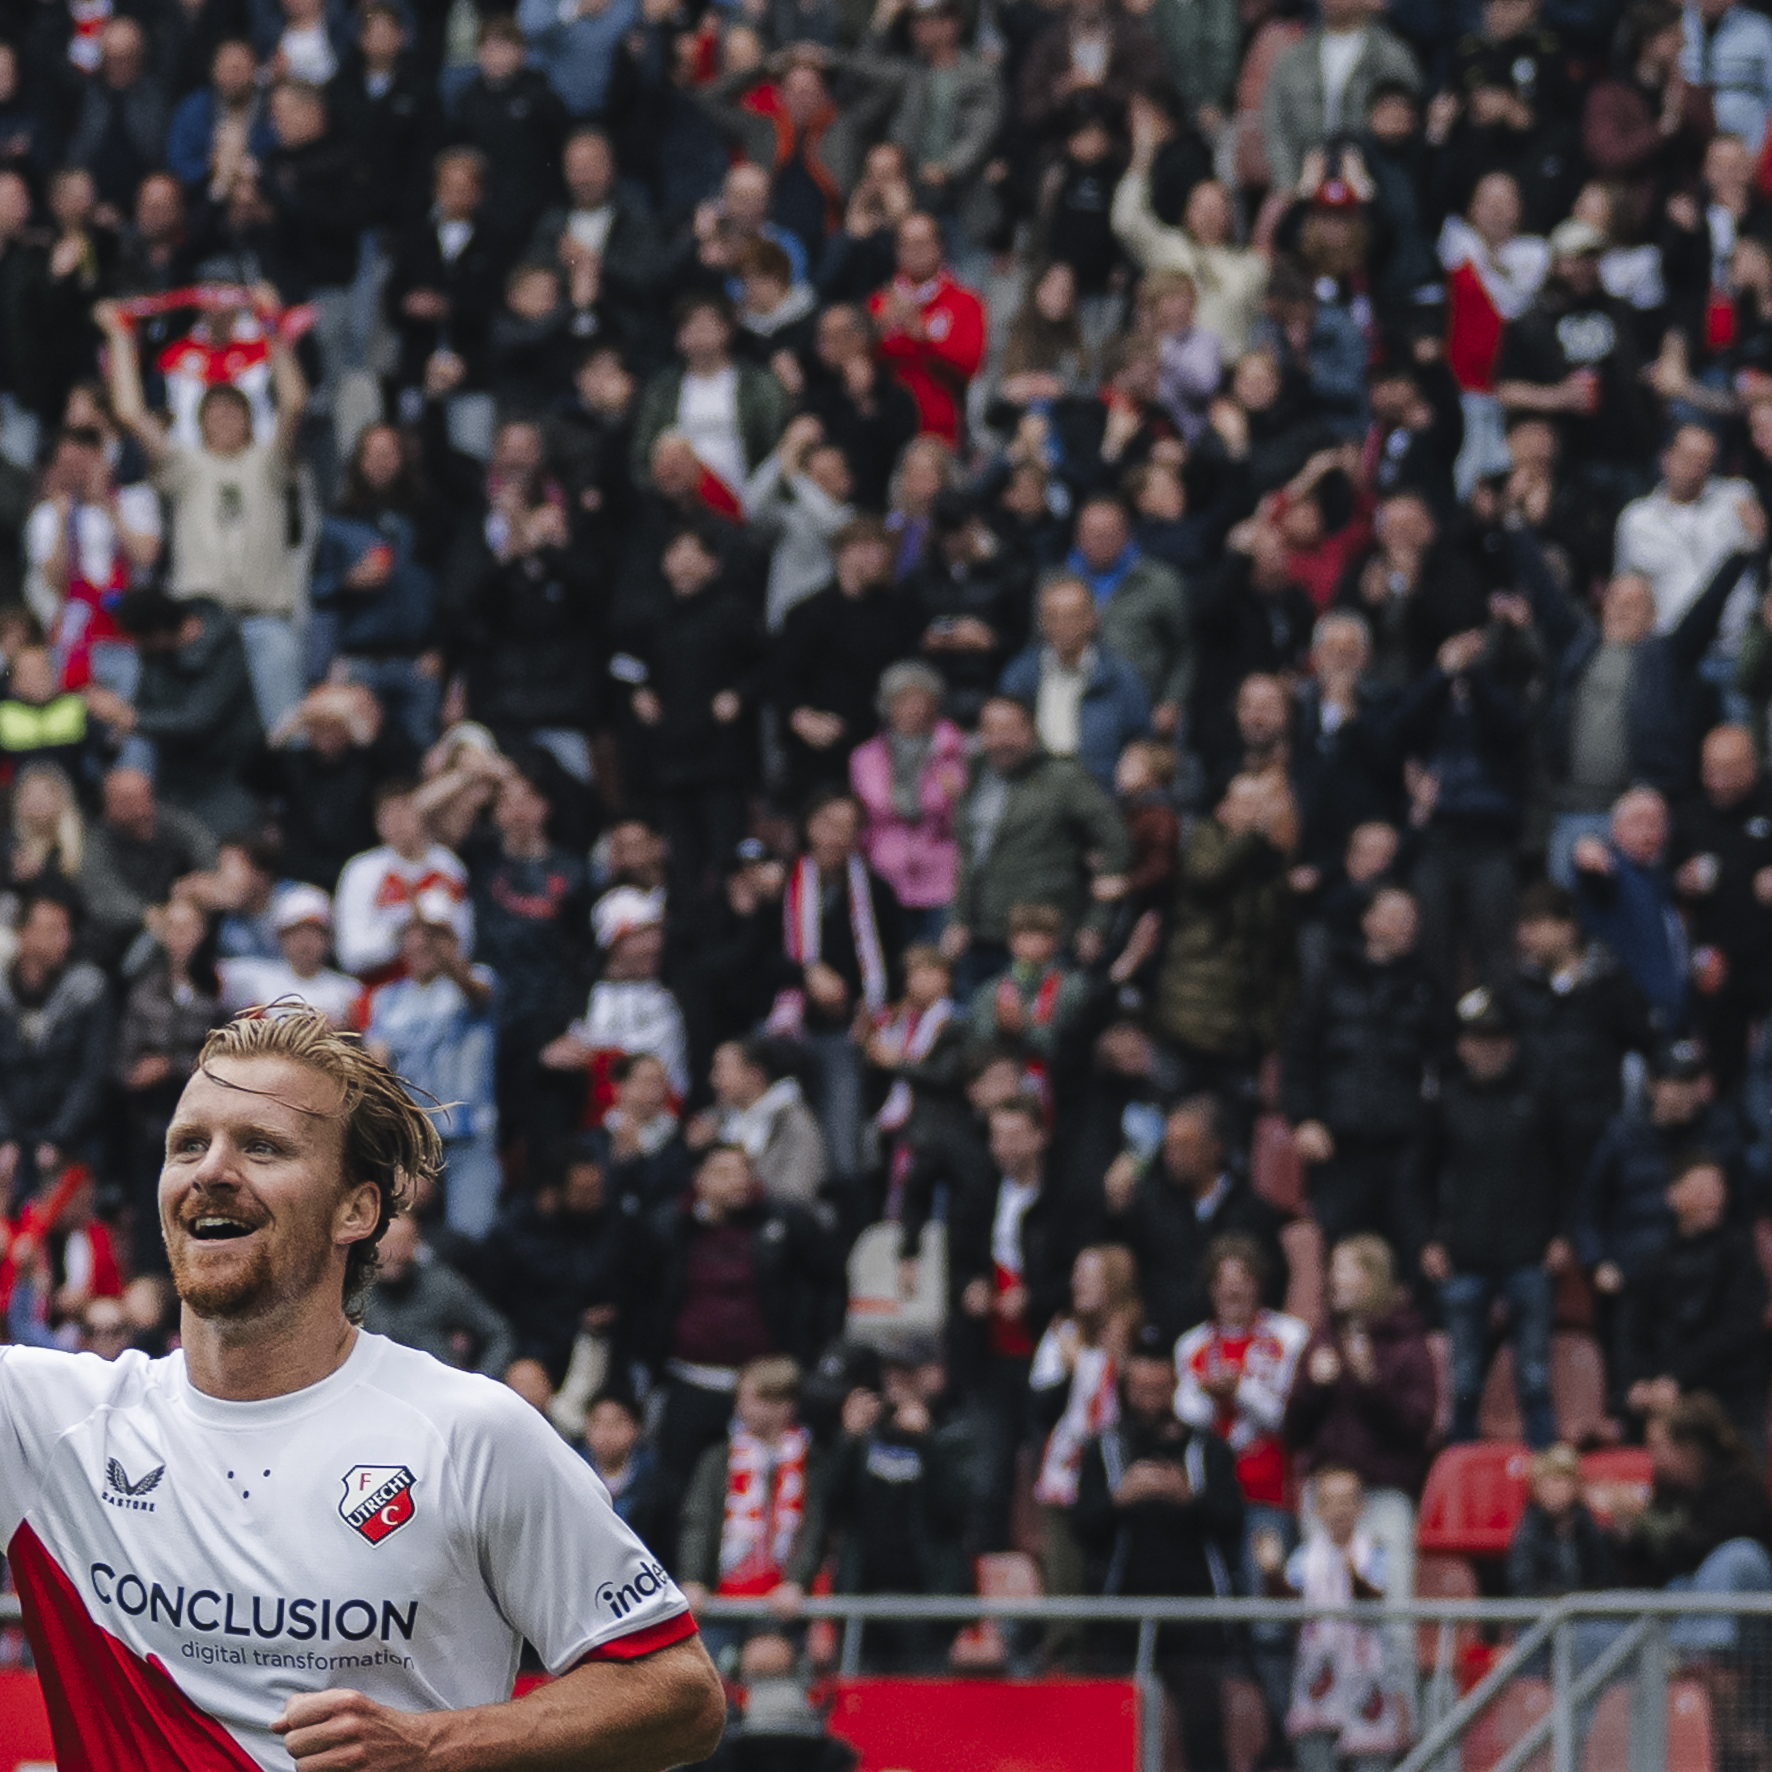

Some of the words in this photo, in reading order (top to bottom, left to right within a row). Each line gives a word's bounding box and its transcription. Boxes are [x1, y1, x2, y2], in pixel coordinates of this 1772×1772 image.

[347, 1470, 412, 1528] UTRECHT
[90, 1562, 420, 1642] CONCLUSION
[181, 1640, 247, 1666] digital
[252, 1648, 415, 1671] transformation
